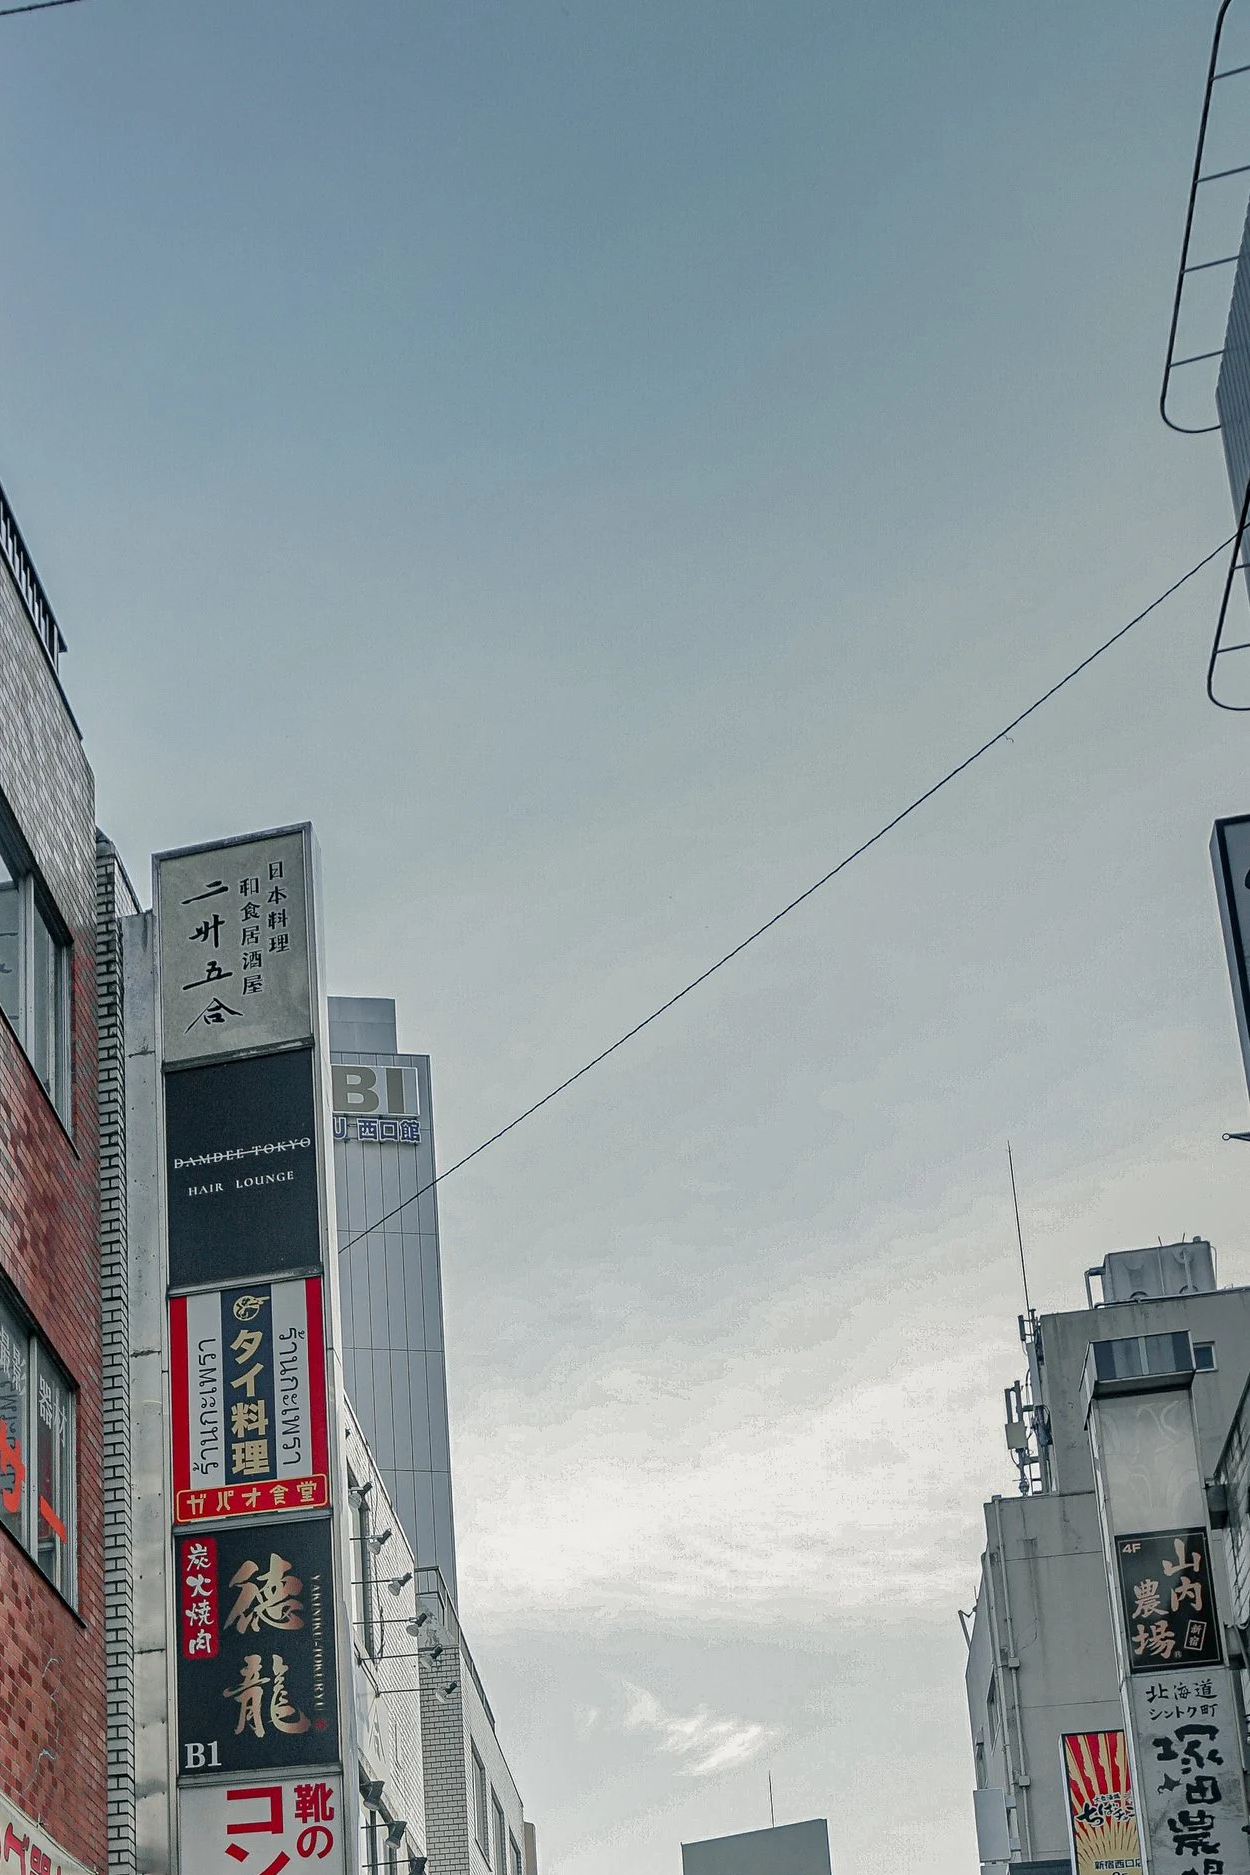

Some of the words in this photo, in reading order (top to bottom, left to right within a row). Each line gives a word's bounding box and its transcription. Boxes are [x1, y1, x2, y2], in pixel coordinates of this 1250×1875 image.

[240, 877, 264, 996] 和食居酒屋
[268, 862, 291, 953] 日本料理
[358, 1117, 422, 1145] 西口館
[188, 1181, 224, 1197] HAIR
[235, 1170, 295, 1190] LOUNGE
[230, 1328, 270, 1476] タイ料理
[1122, 1543, 1141, 1554] 4F
[1162, 1538, 1204, 1612] 山内
[185, 1543, 215, 1655] 炭火焼肉
[1131, 1579, 1177, 1660] 農場
[1145, 1679, 1218, 1701] 北海道
[1149, 1703, 1219, 1721] シントク町
[184, 1741, 223, 1769] B1
[294, 1783, 336, 1860] 靴の
